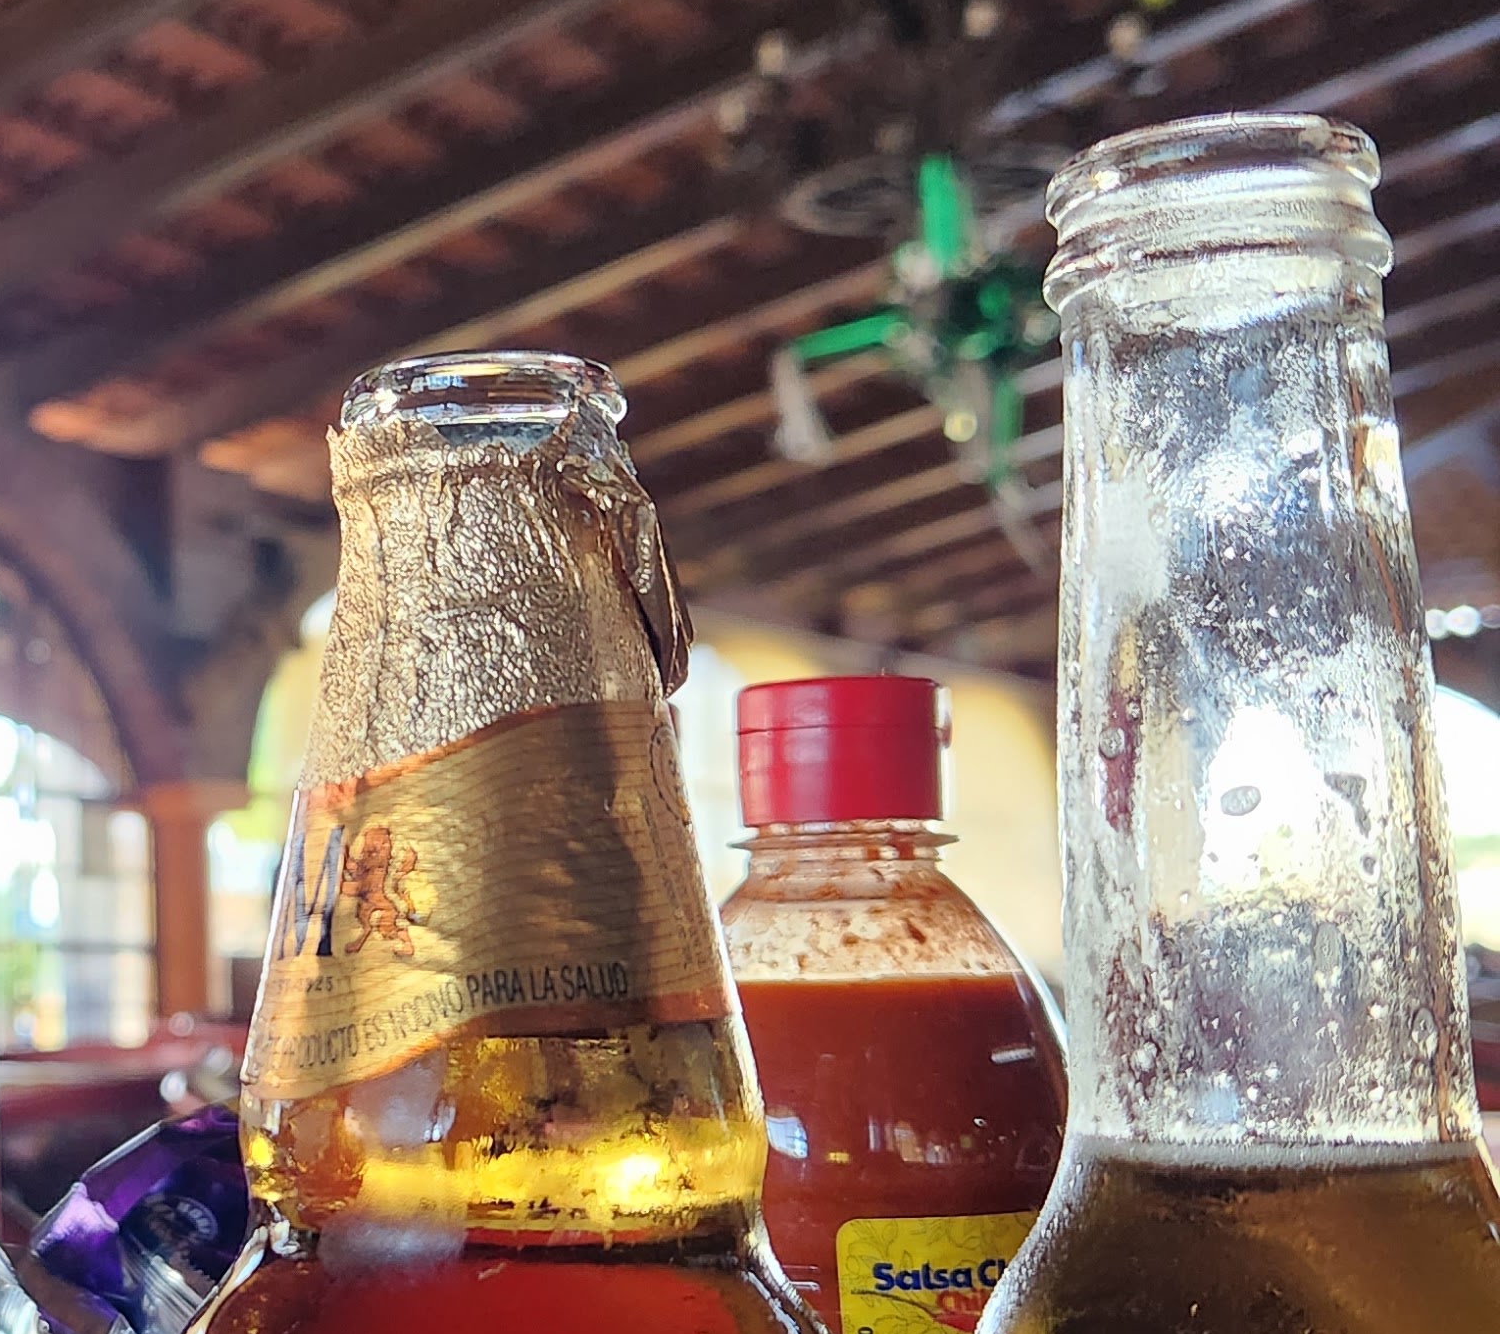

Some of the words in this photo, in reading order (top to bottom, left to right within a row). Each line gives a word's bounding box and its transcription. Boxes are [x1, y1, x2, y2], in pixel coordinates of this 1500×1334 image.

[465, 969, 526, 1008] PARA
[529, 967, 554, 1001] LA
[560, 961, 630, 1001] SALUD
[873, 1261, 974, 1291] Salsa
